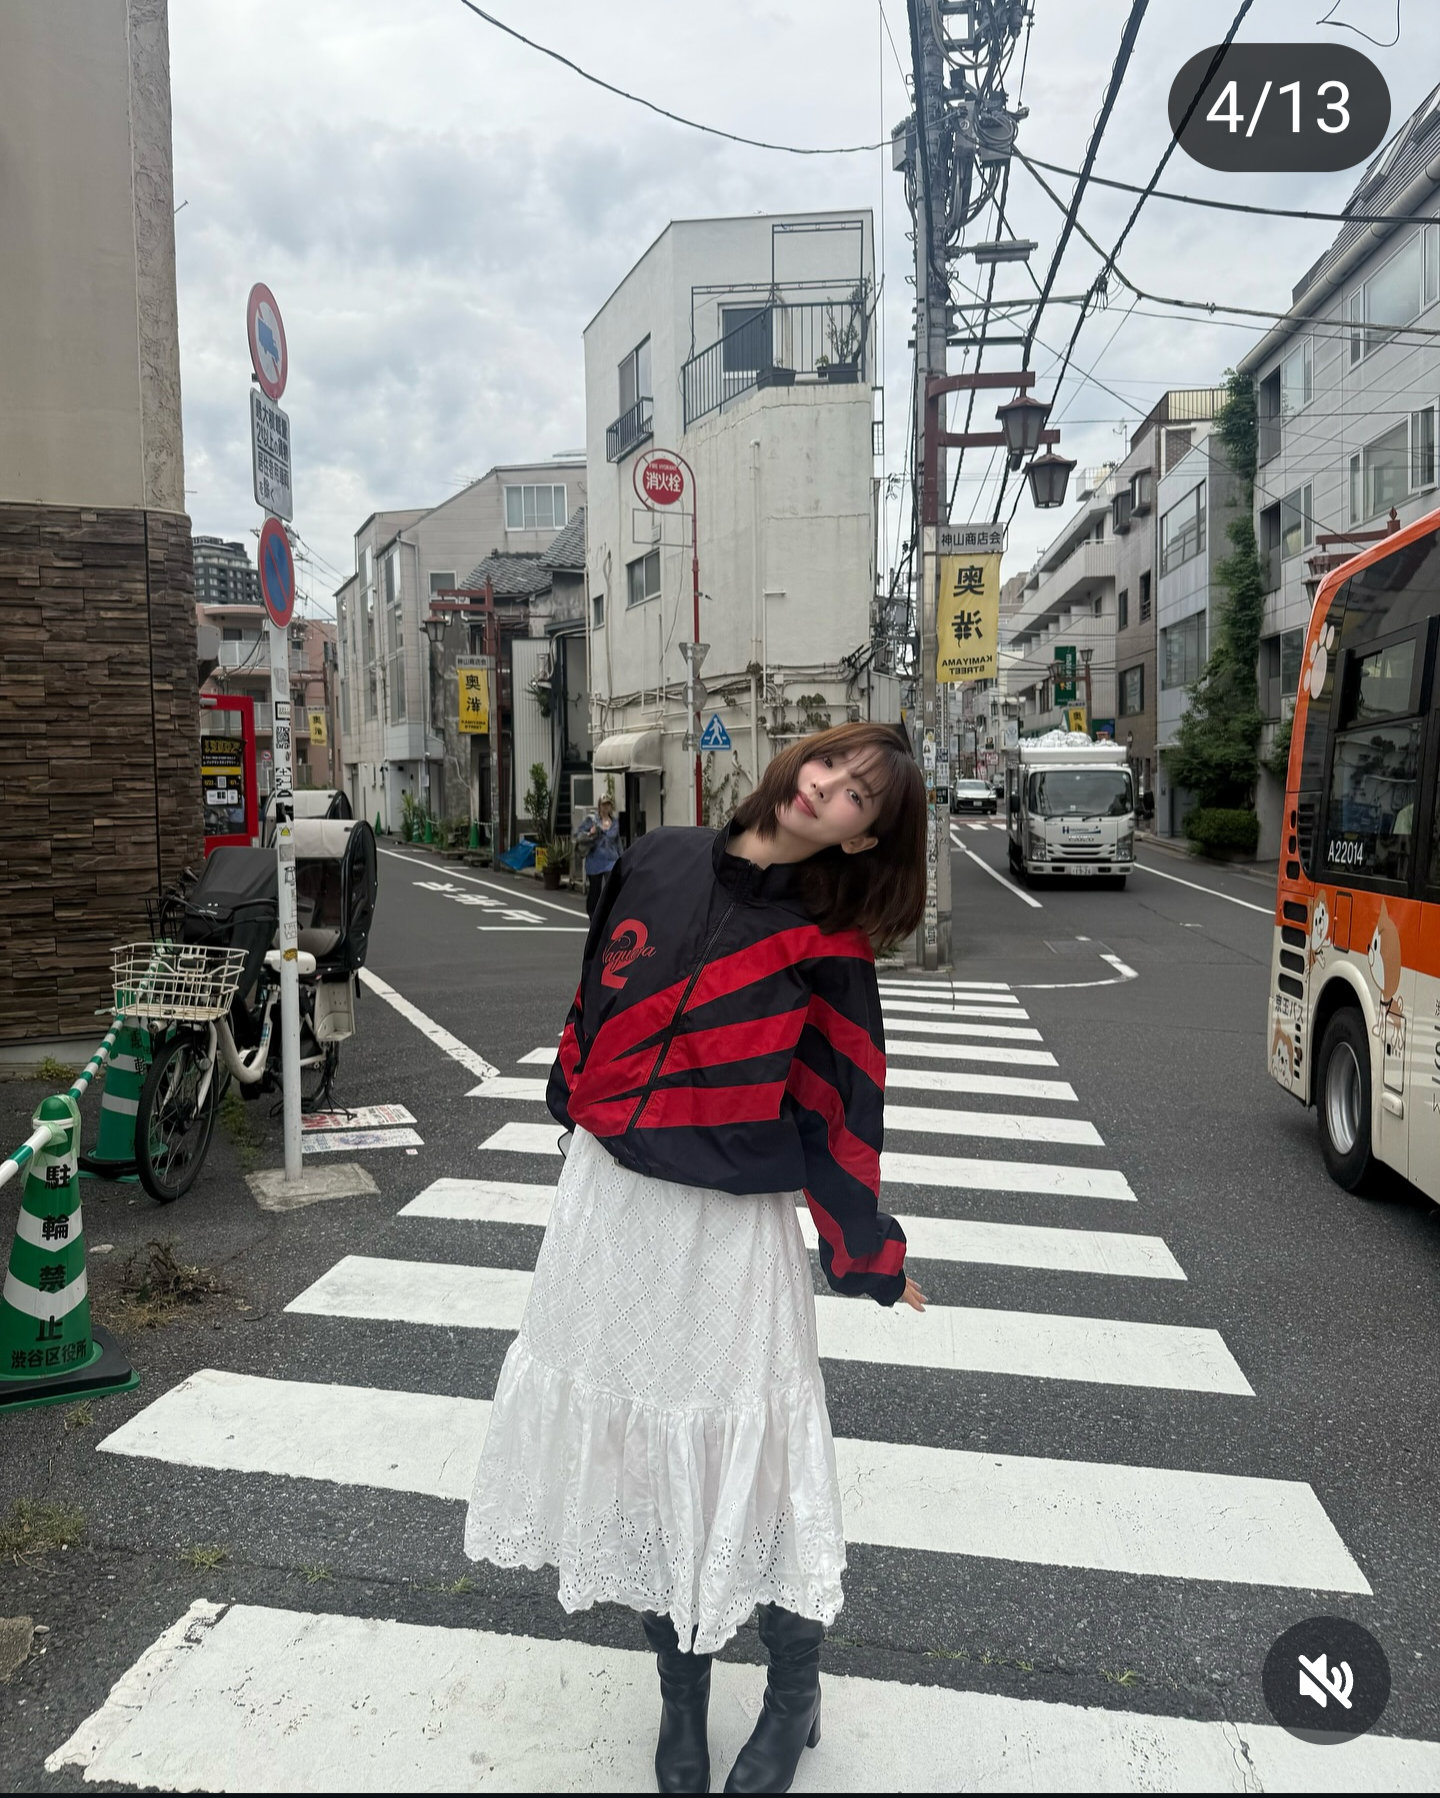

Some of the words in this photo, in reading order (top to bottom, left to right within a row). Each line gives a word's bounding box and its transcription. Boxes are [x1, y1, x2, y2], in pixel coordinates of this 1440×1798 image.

[646, 471, 681, 493] 消火栓
[941, 531, 1001, 547] 神山商店会
[1328, 840, 1363, 866] A22014
[1275, 994, 1304, 1024] 京王バス
[35, 1164, 71, 1342] 駐輪禁止
[11, 1338, 87, 1370] 渋谷区役所
